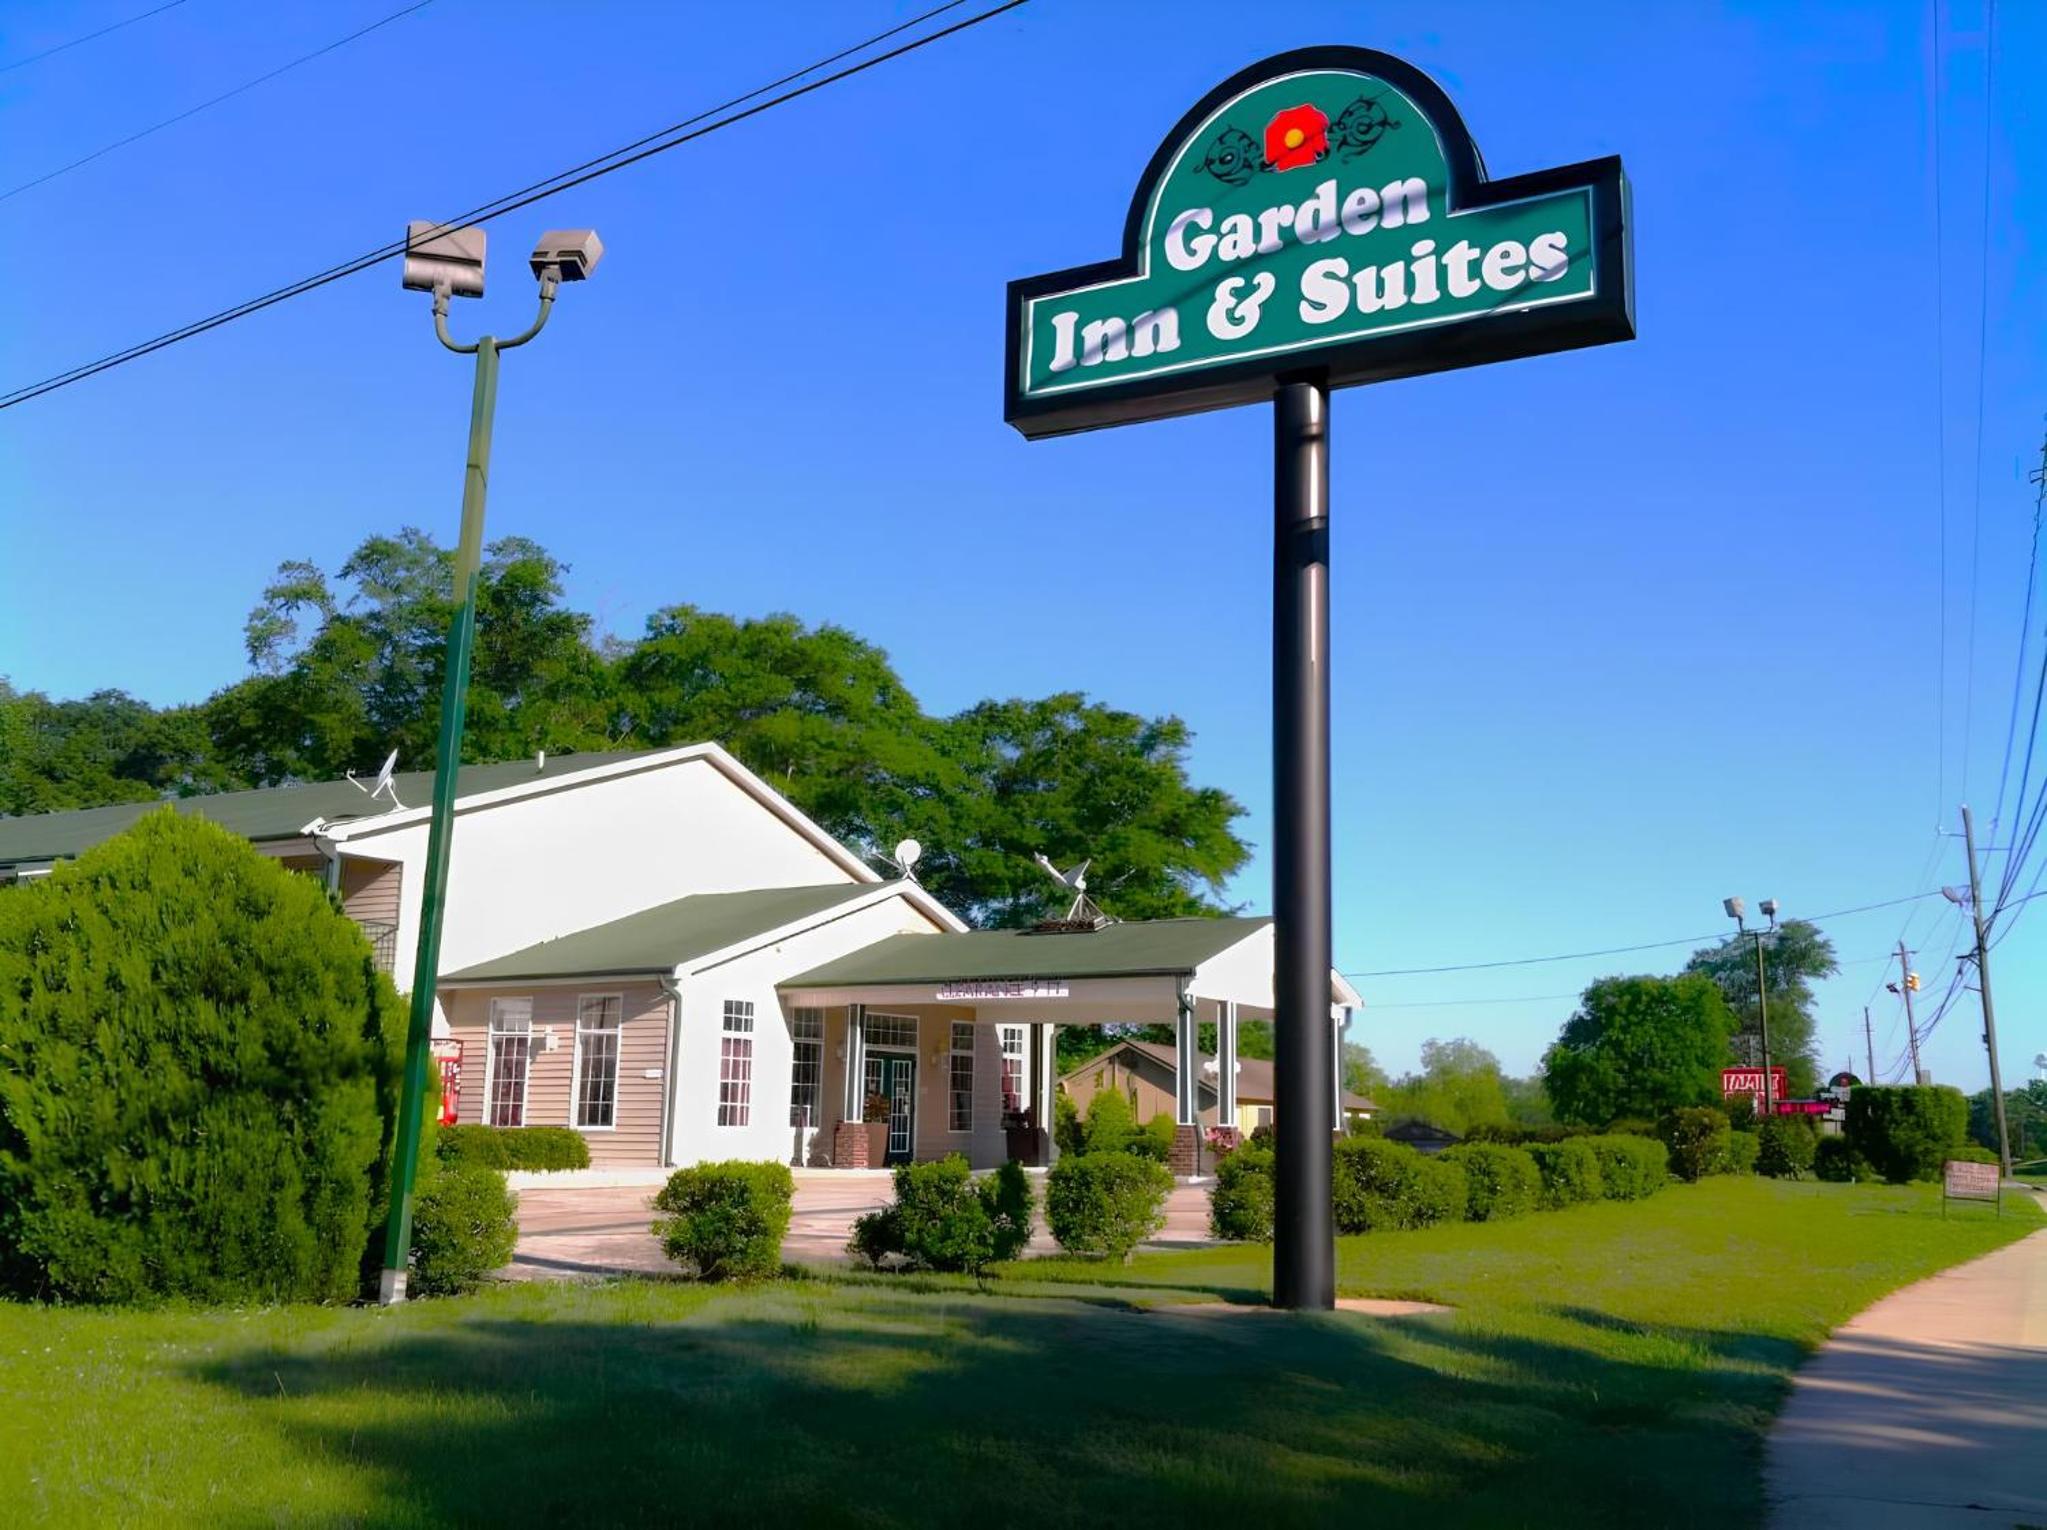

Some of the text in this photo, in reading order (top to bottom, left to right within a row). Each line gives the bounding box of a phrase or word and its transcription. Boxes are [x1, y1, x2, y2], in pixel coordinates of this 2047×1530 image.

[1164, 177, 1431, 271] Garden
[1049, 231, 1569, 372] Inn & Suites
